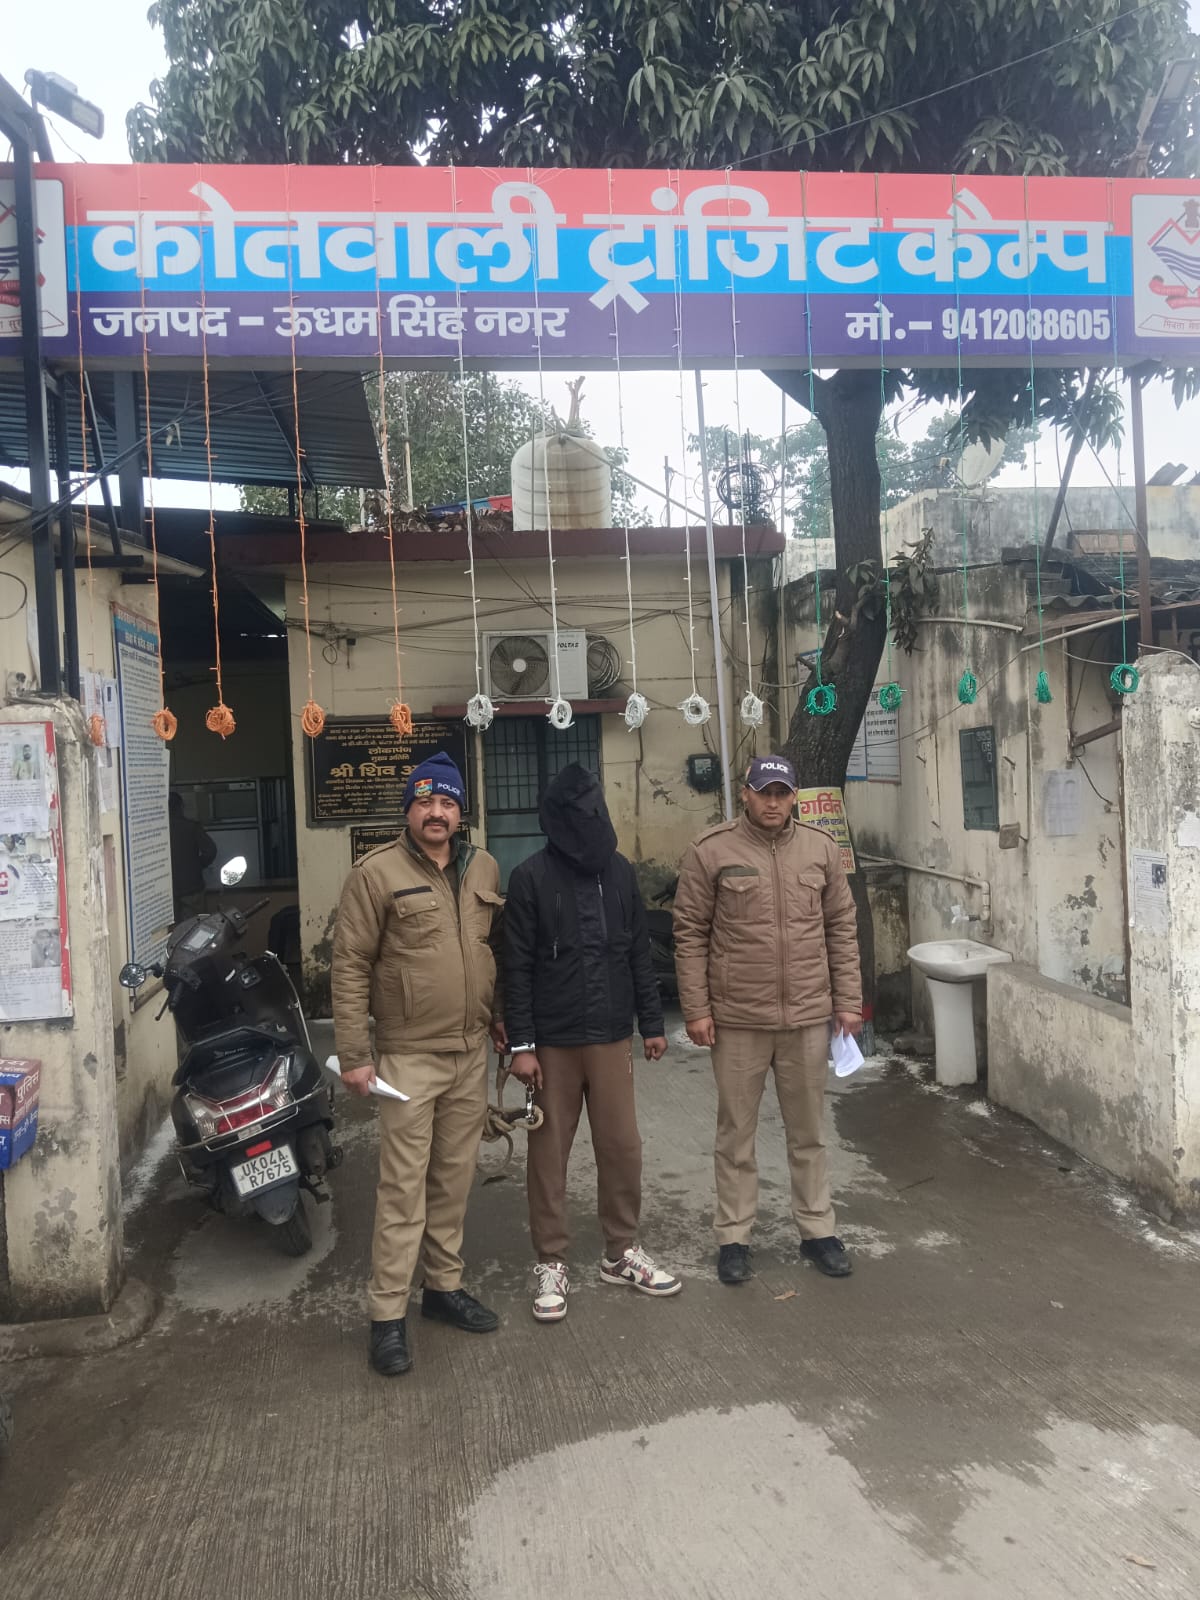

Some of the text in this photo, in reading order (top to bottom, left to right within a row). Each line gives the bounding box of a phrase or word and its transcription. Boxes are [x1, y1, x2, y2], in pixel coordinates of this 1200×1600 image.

[87, 182, 1115, 314] कोतवाली ट्रांजिट कैम्प
[89, 306, 230, 337] जनपद
[274, 306, 378, 338] ऊधम
[387, 294, 467, 340] सिंह
[474, 307, 569, 338] नगर
[942, 308, 1110, 341] 9412088605
[330, 763, 354, 778] श्री
[359, 762, 397, 777] शिव
[760, 762, 789, 774] POLICE
[437, 782, 461, 796] POLICE
[249, 1160, 292, 1188] R7675
